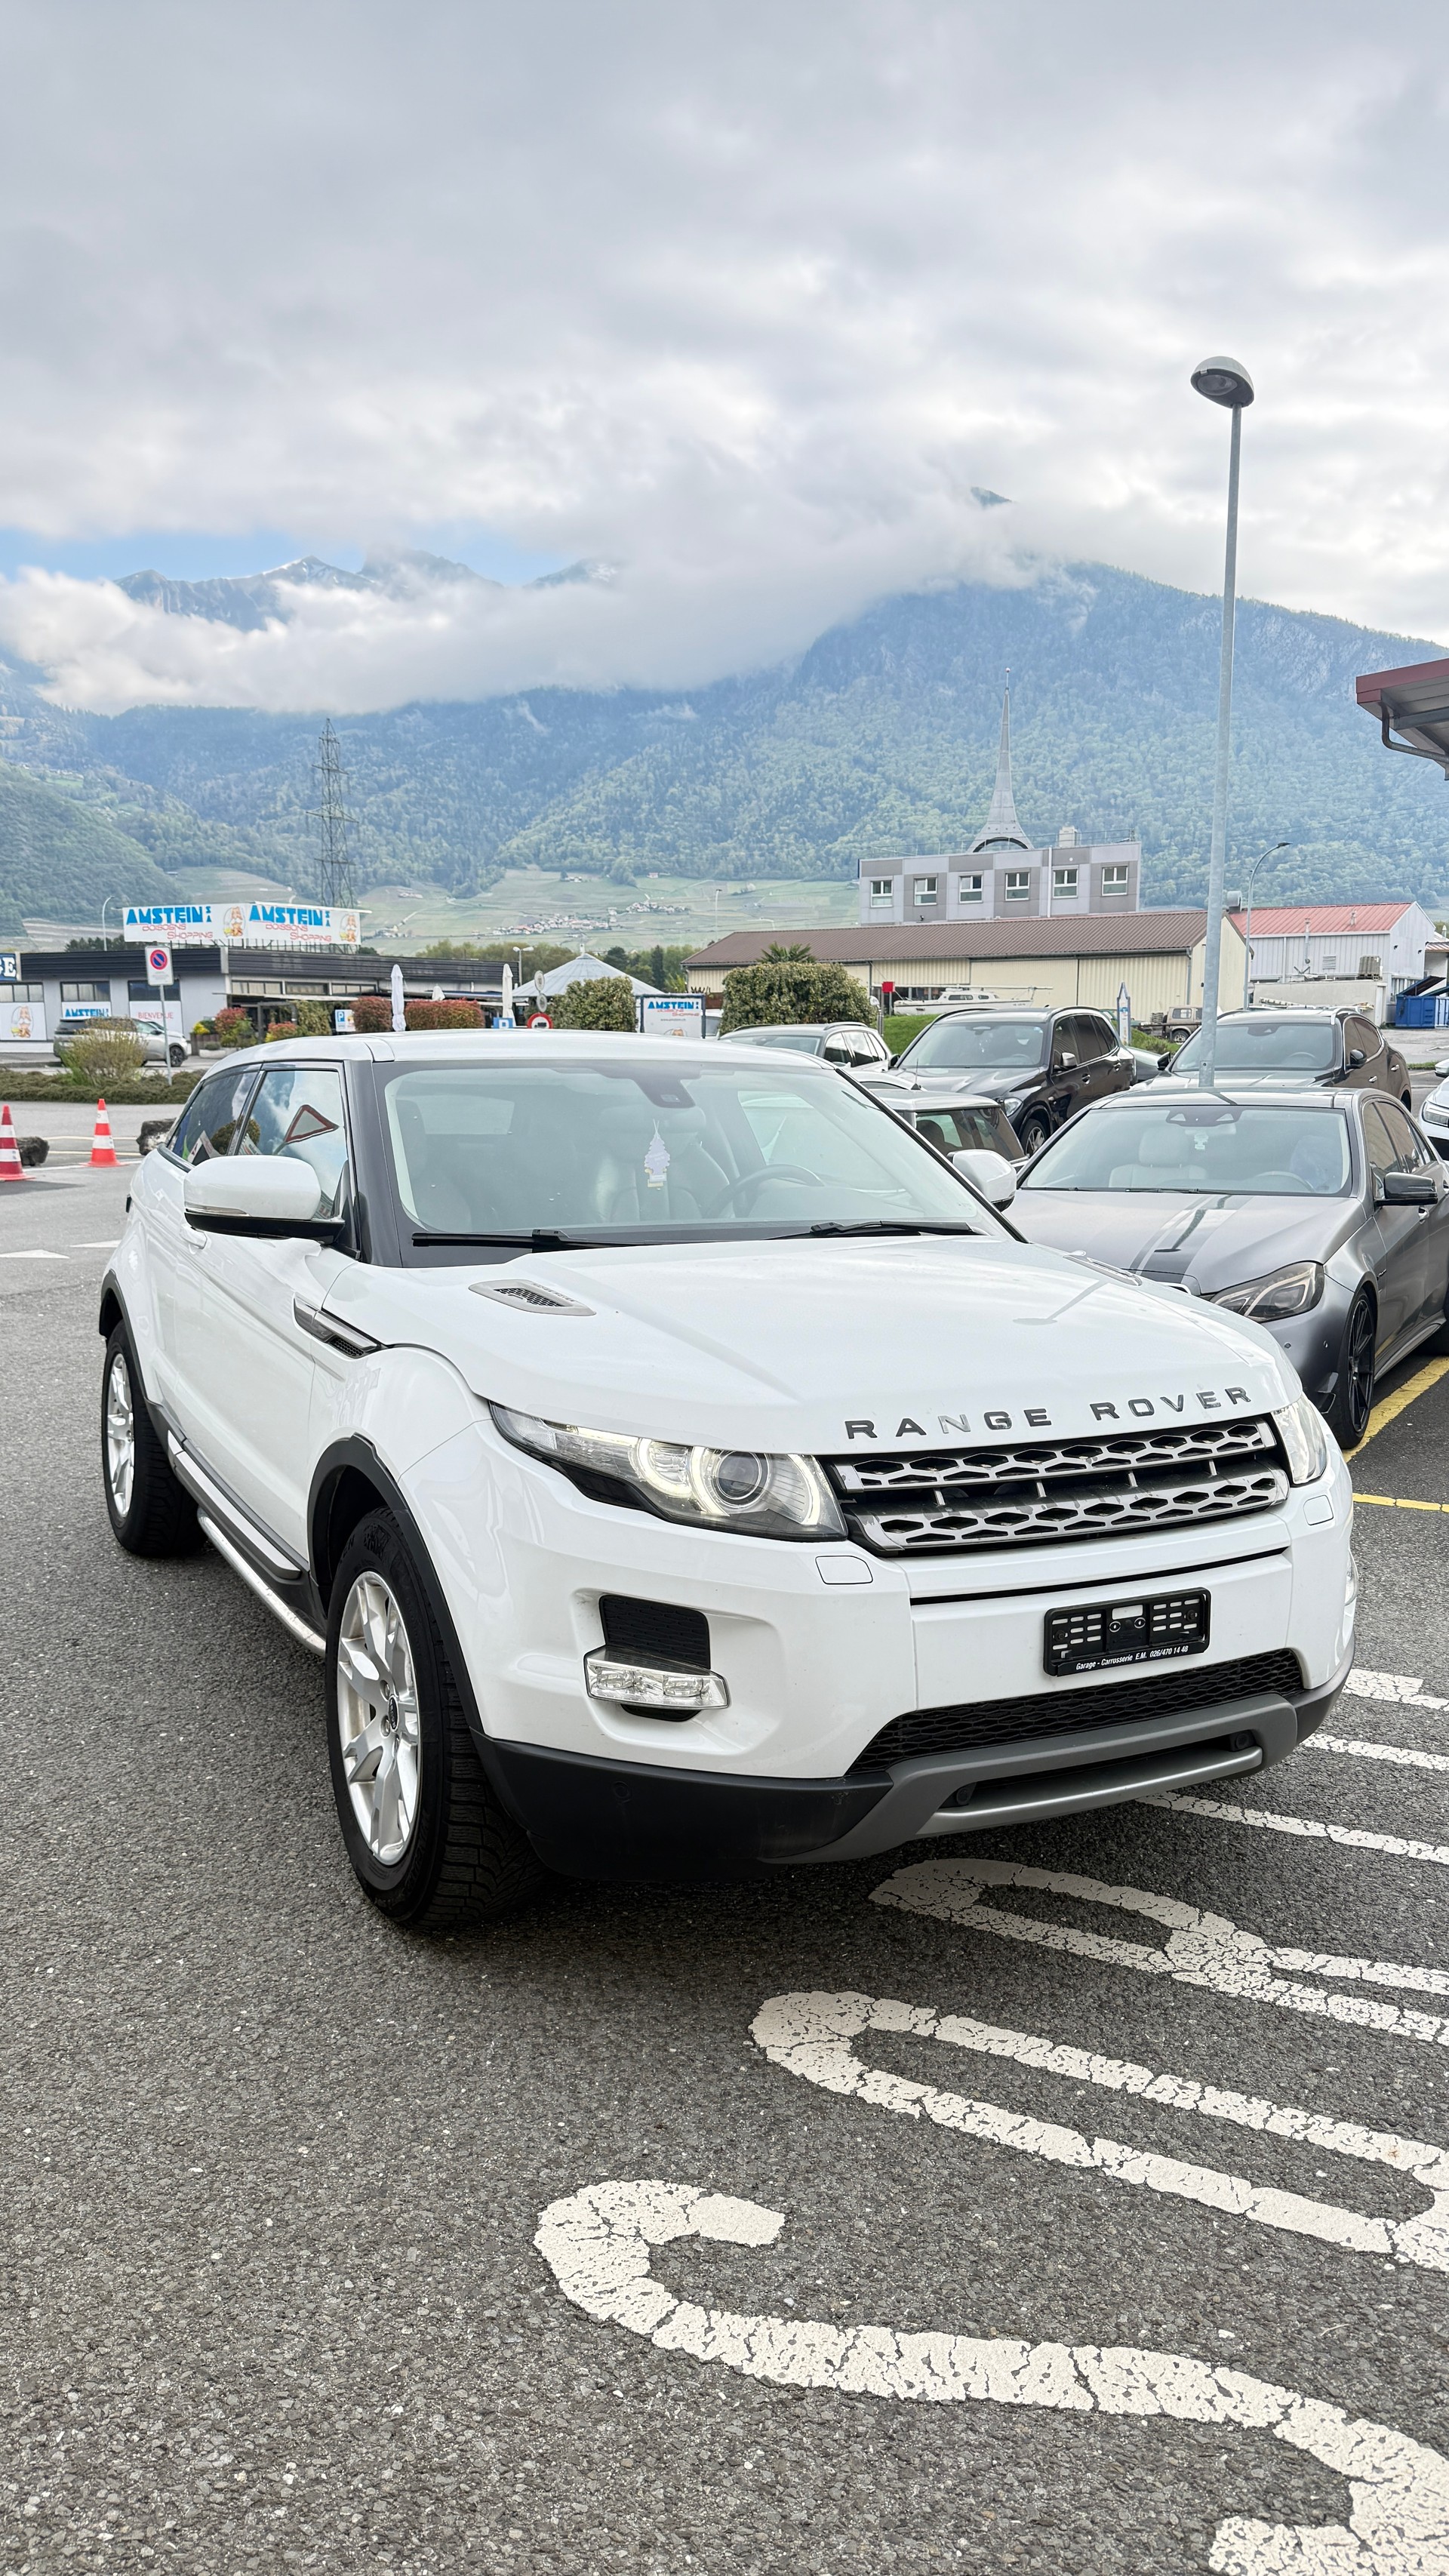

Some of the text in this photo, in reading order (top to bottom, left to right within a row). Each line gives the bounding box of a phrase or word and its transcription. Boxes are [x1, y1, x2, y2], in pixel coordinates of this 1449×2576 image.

[126, 906, 203, 925] AMSTEIN
[249, 905, 323, 926] AMSTEIN
[167, 931, 213, 940] SHOPPING
[290, 931, 332, 942] SHOPPING
[65, 1008, 104, 1017] AMSTEIN
[648, 1001, 694, 1010] AMSTEIN
[844, 1386, 1251, 1439] RANGE ROVER
[1076, 1662, 1096, 1670] Garage
[1135, 1652, 1147, 1660] E.M.
[1149, 1648, 1173, 1657] 026/470
